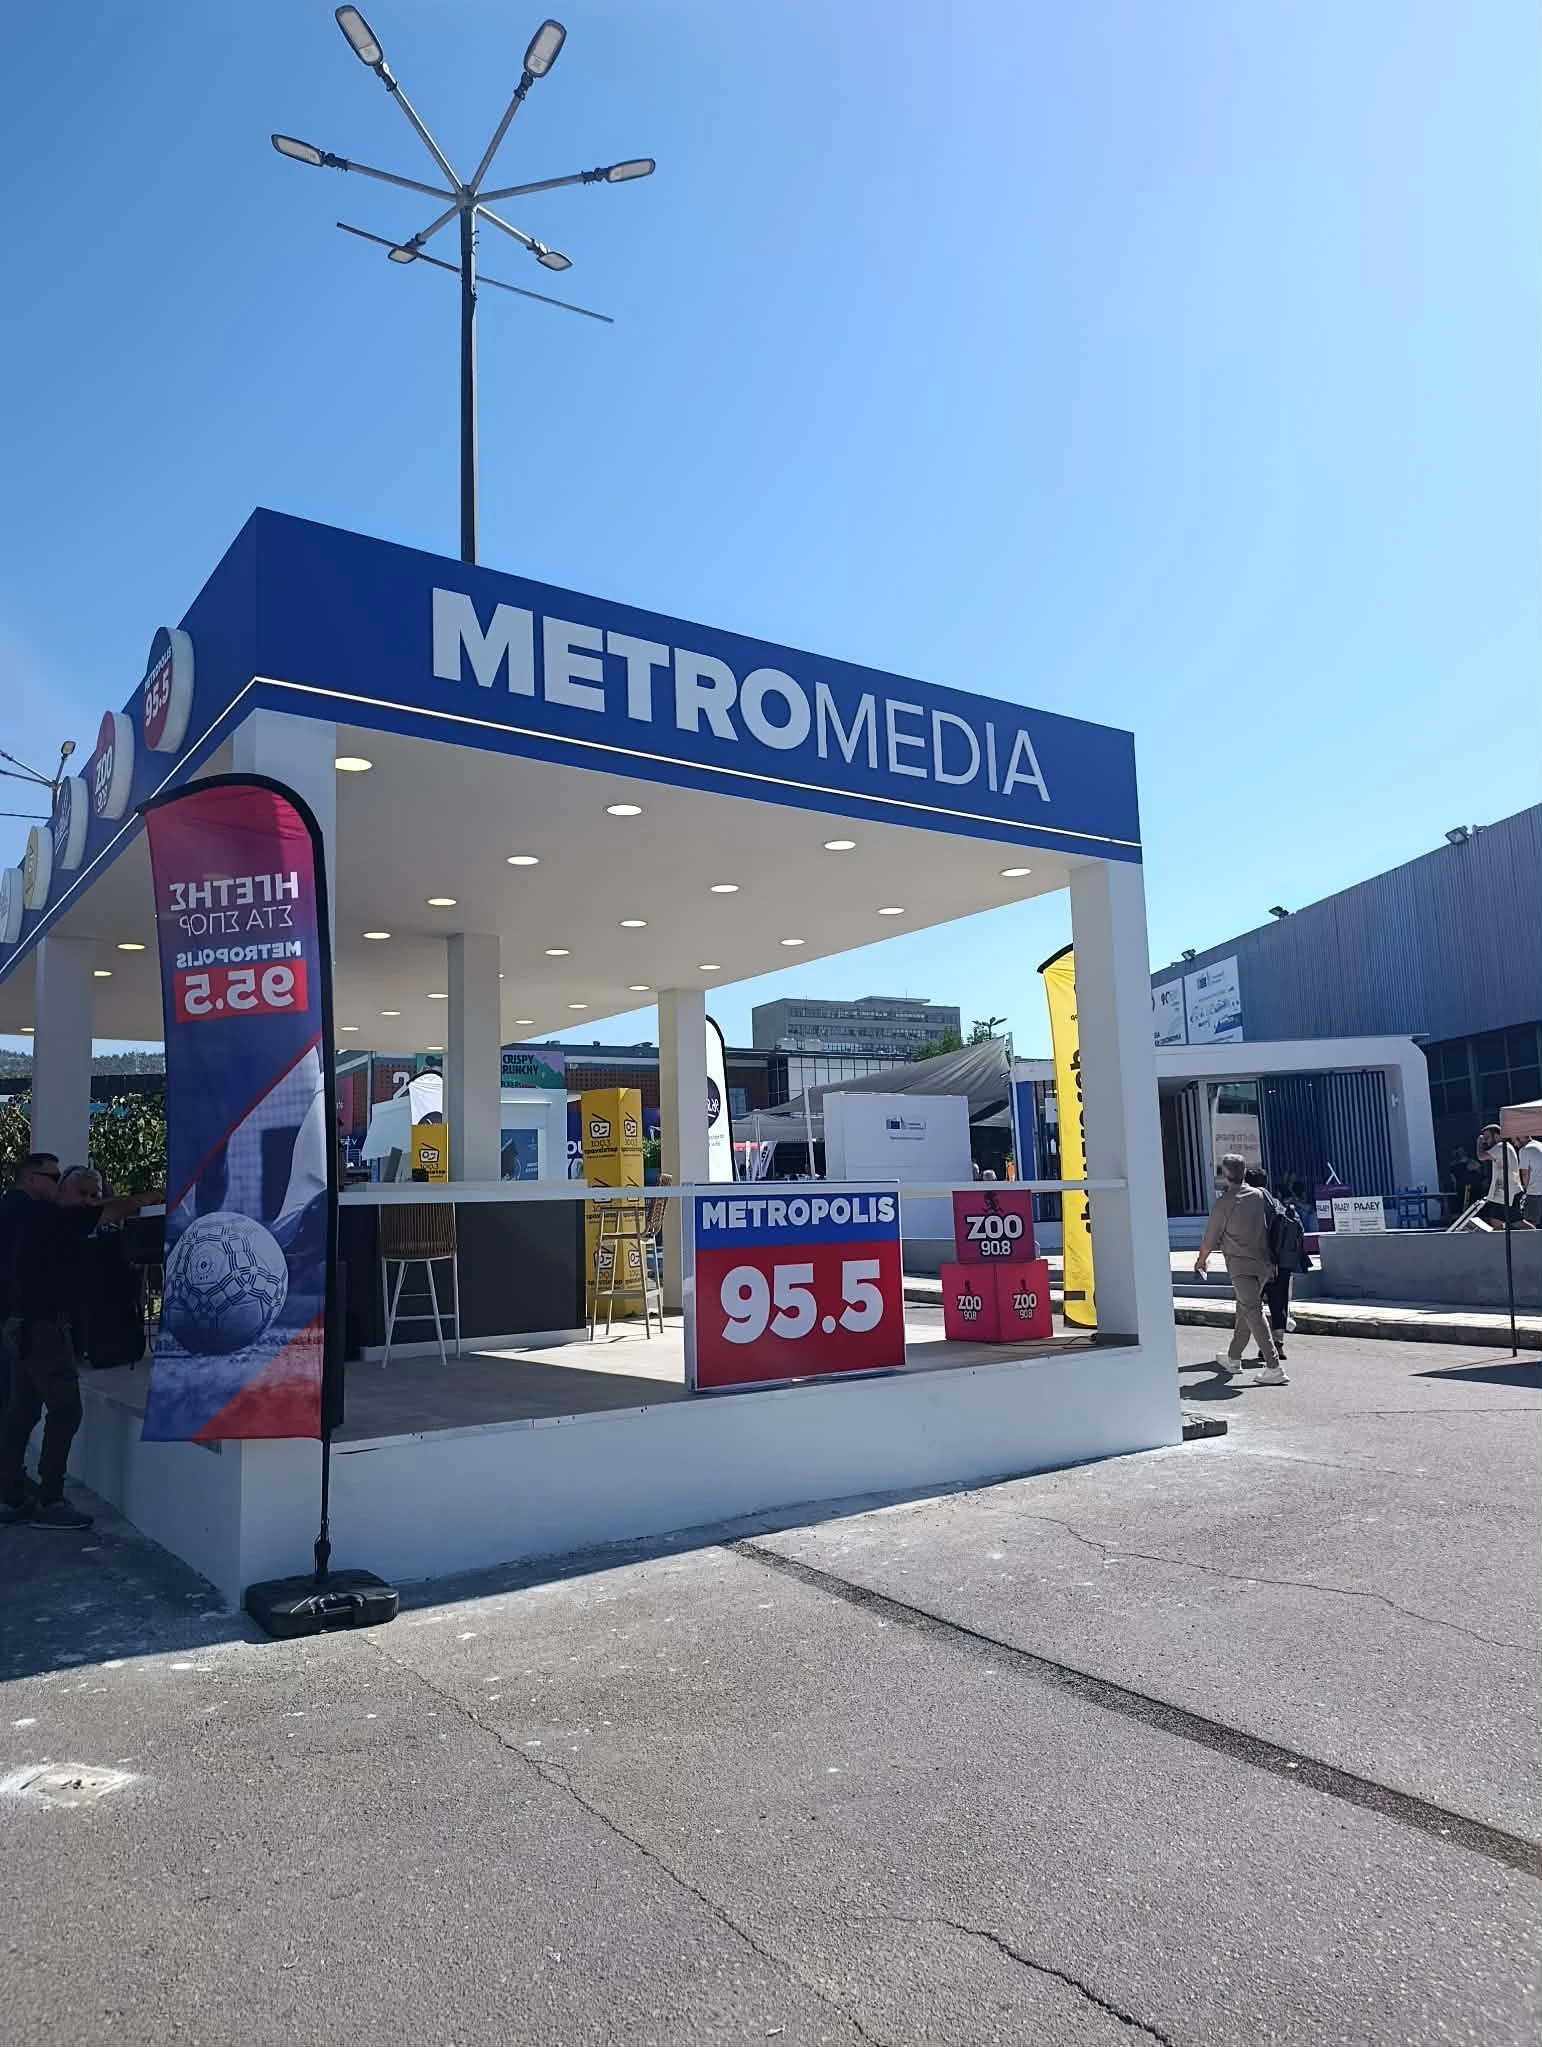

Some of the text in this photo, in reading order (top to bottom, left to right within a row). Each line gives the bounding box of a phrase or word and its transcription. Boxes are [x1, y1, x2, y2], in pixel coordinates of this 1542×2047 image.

[145, 666, 170, 728] 95.5
[433, 587, 1051, 803] METROMEDIA
[95, 745, 113, 795] ZOO
[502, 1065, 539, 1075] RUNCHY
[503, 1054, 535, 1065] CRISPY
[702, 1197, 896, 1230] METROPOLIS
[966, 1214, 1023, 1240] ZOO
[981, 1240, 1011, 1256] 90.8
[720, 1259, 885, 1345] 95.5
[957, 1295, 982, 1310] ZOO
[1013, 1293, 1037, 1309] ZOO
